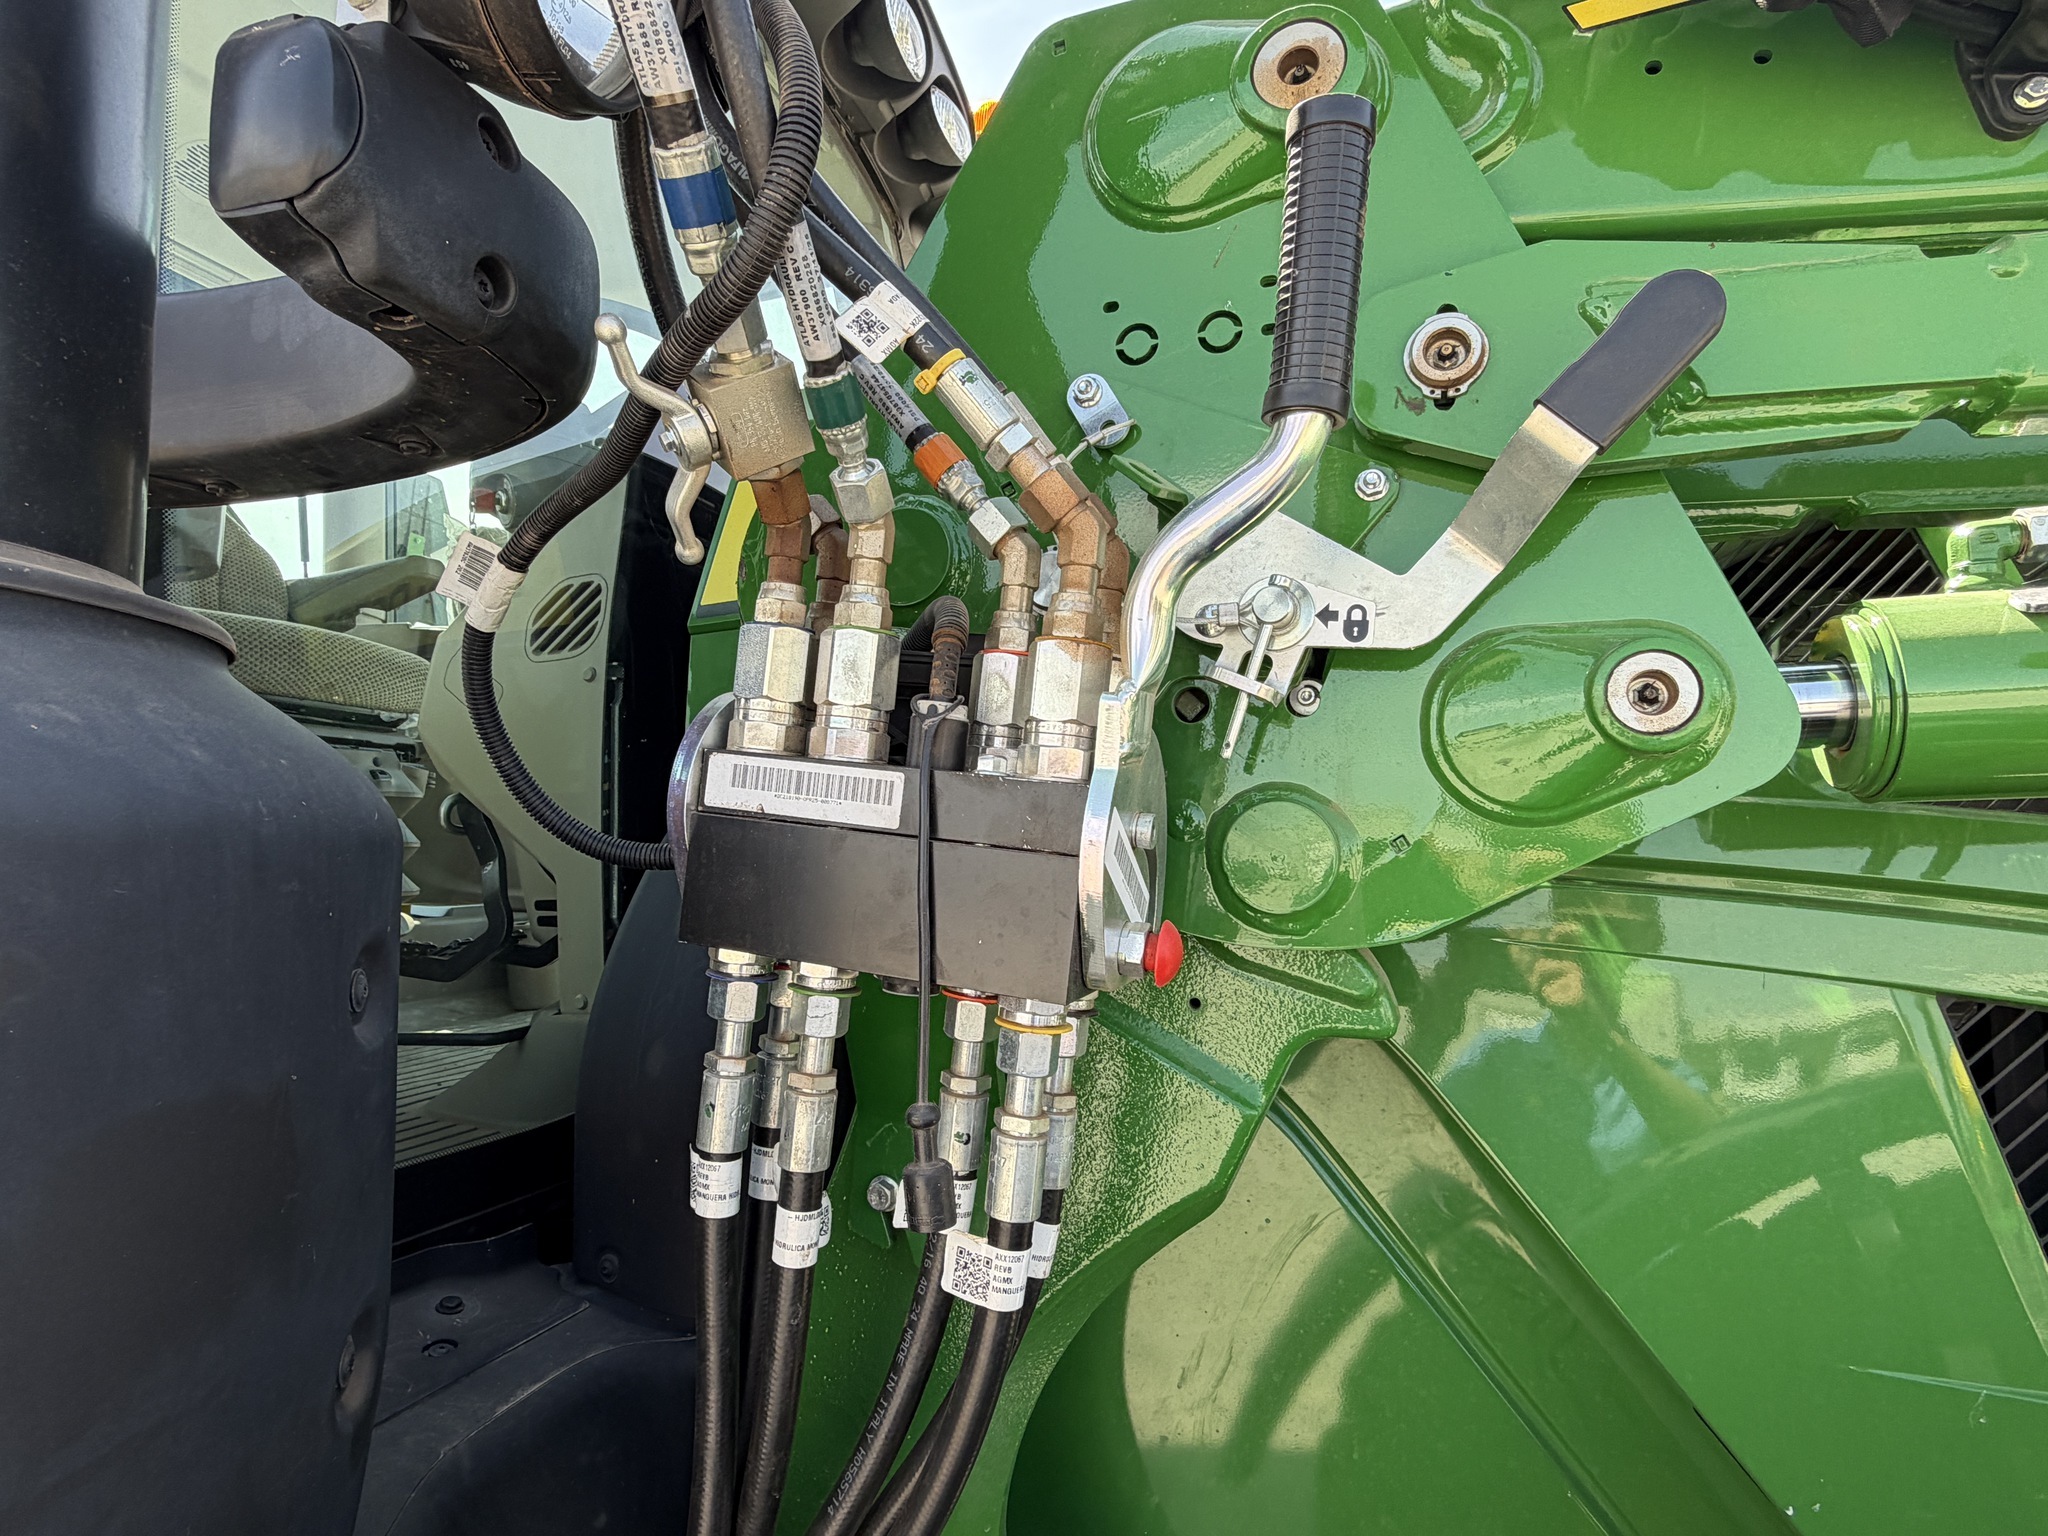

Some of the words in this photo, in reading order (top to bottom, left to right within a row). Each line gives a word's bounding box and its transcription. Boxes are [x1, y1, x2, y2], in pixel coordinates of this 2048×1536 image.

[660, 19, 678, 56] 4000
[631, 46, 650, 90] ATLAS
[635, 21, 663, 90] AW37885
[672, 60, 685, 84] PSI
[786, 244, 794, 254] C
[789, 256, 803, 281] REV
[799, 254, 827, 326] X086820258
[794, 313, 811, 347] ATLAS
[799, 288, 821, 342] AW37900
[863, 380, 877, 395] REV
[994, 1252, 1024, 1264] AXX12067
[907, 1301, 922, 1321] 24
[893, 1327, 915, 1366] MADE
[884, 1371, 898, 1391] IN
[866, 1398, 892, 1443] ITALY
